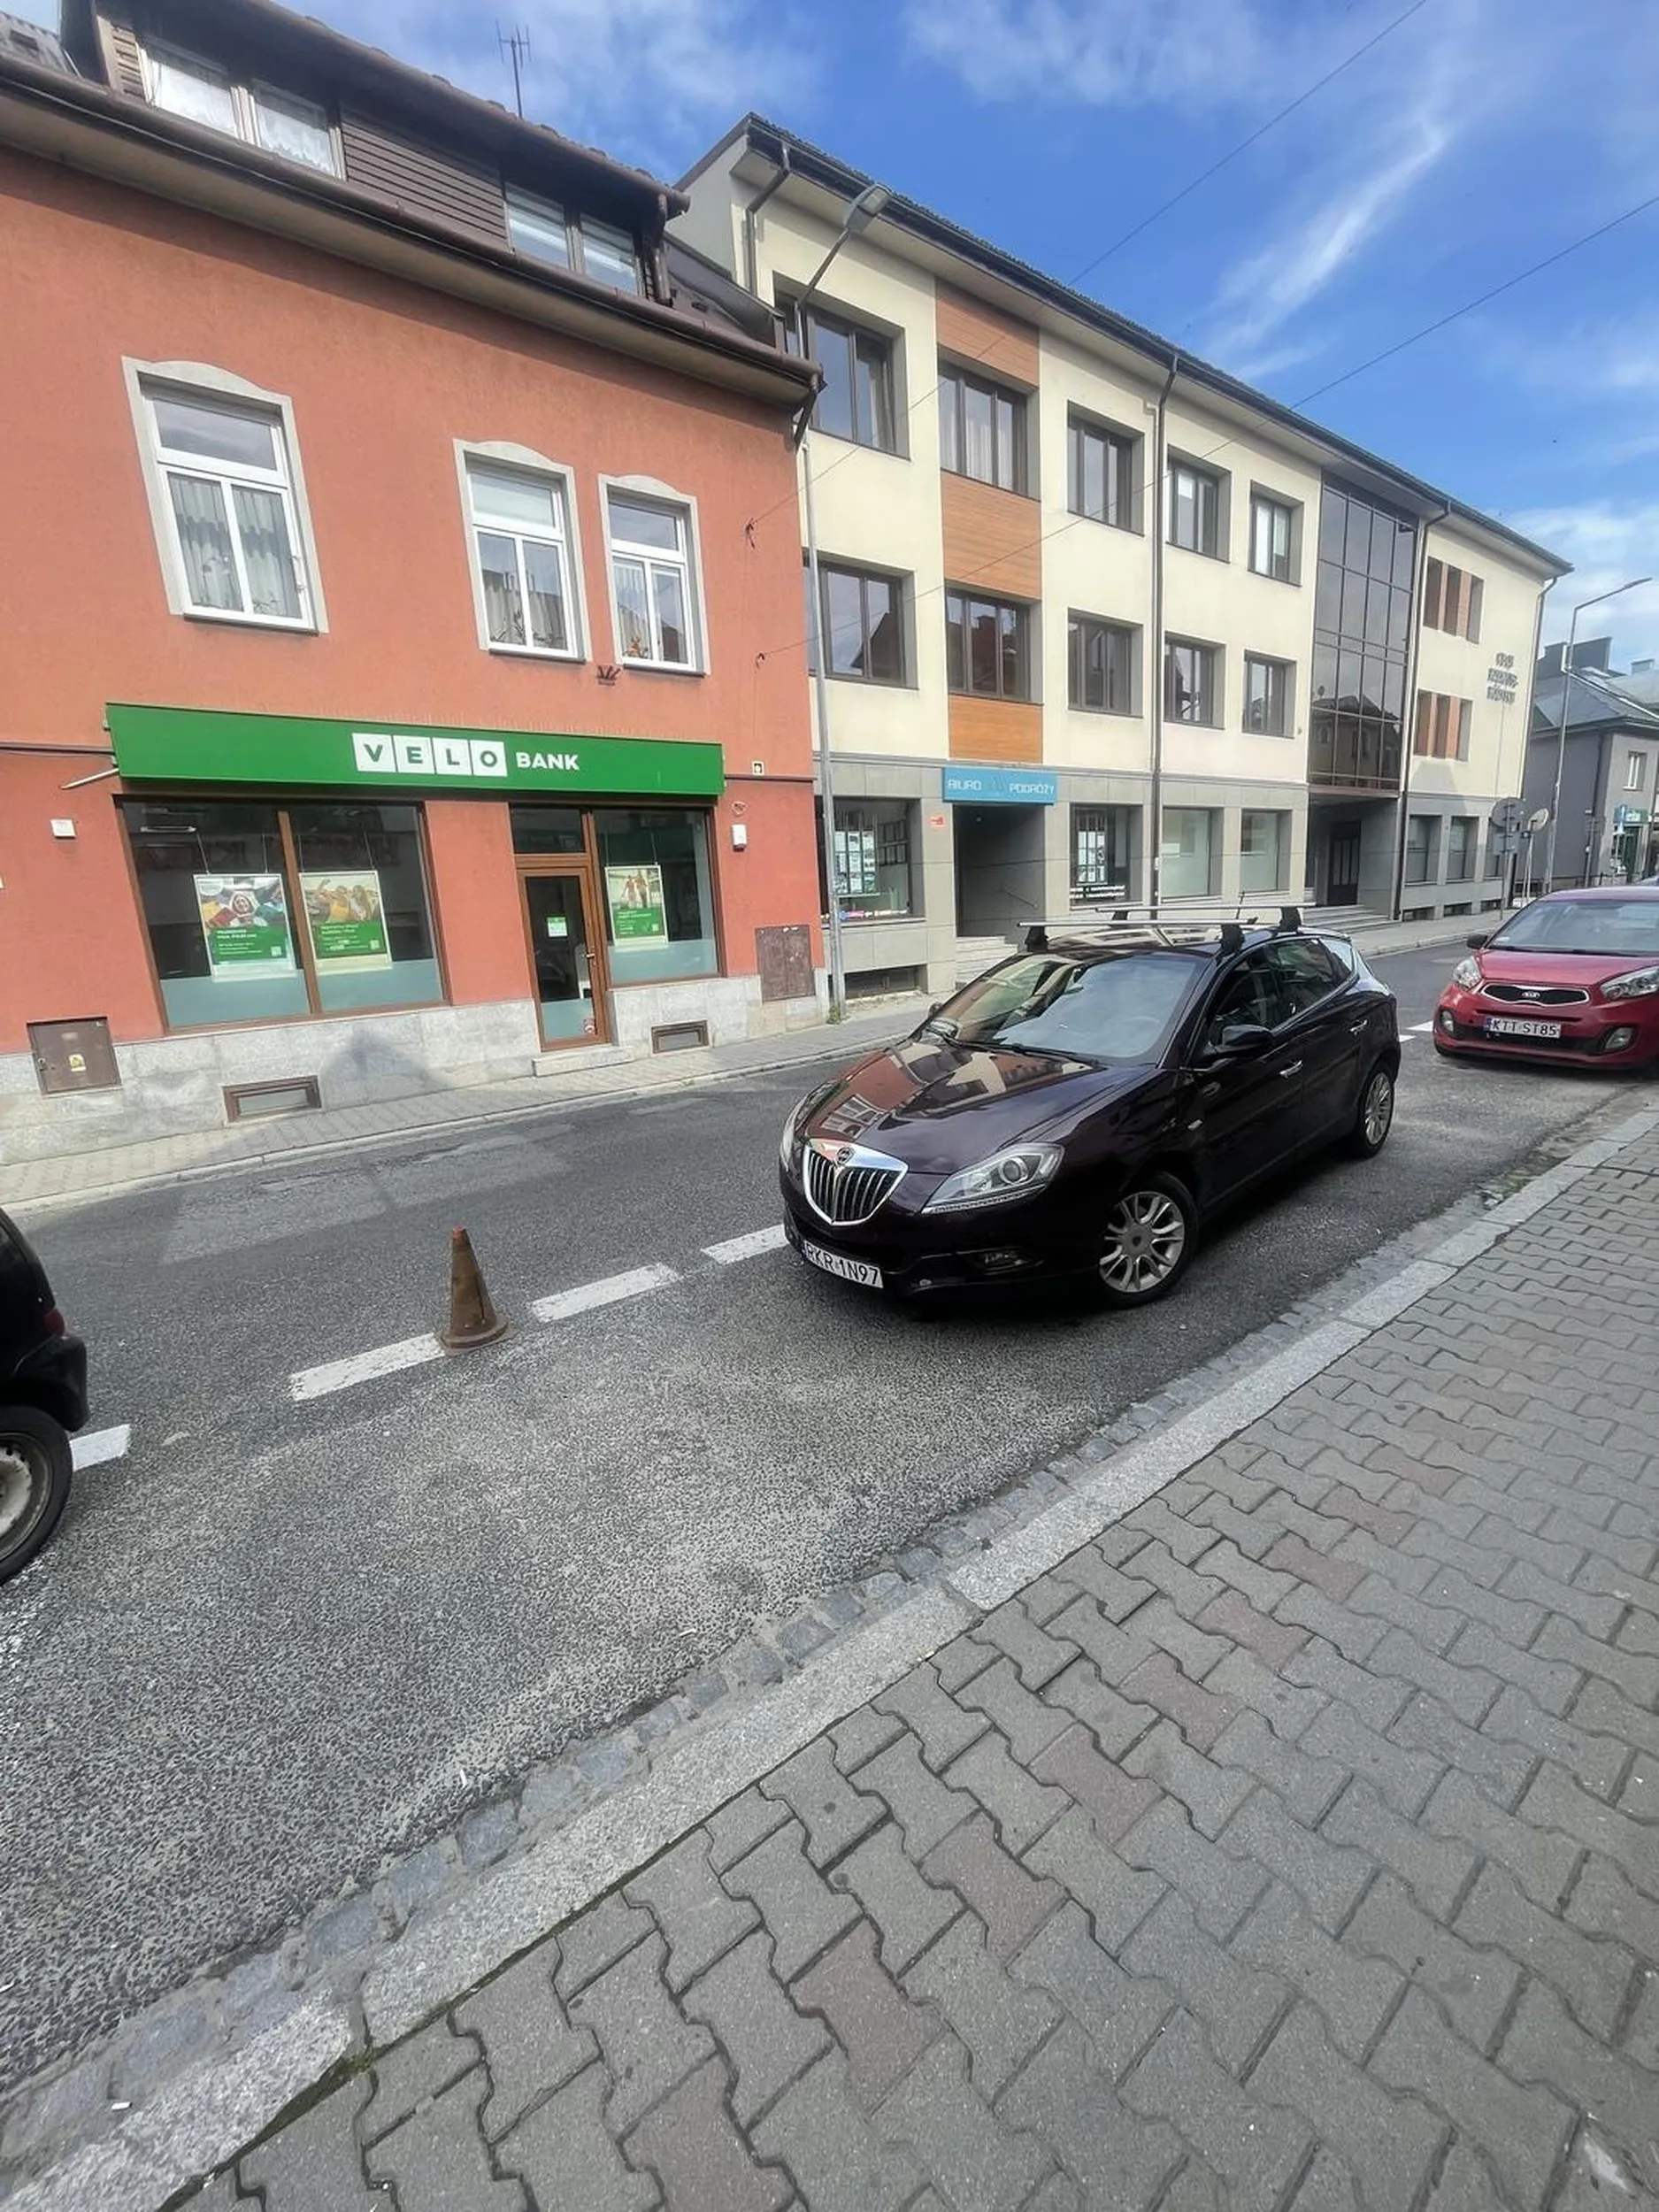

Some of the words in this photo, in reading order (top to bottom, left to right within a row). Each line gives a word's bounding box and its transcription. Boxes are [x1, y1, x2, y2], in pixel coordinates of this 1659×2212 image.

[361, 741, 501, 770] VELO
[516, 752, 580, 770] BANK
[1493, 1019, 1516, 1032] KTT
[1523, 1022, 1557, 1036] ST85
[805, 1242, 834, 1271] RKR
[839, 1259, 878, 1285] 1N97
